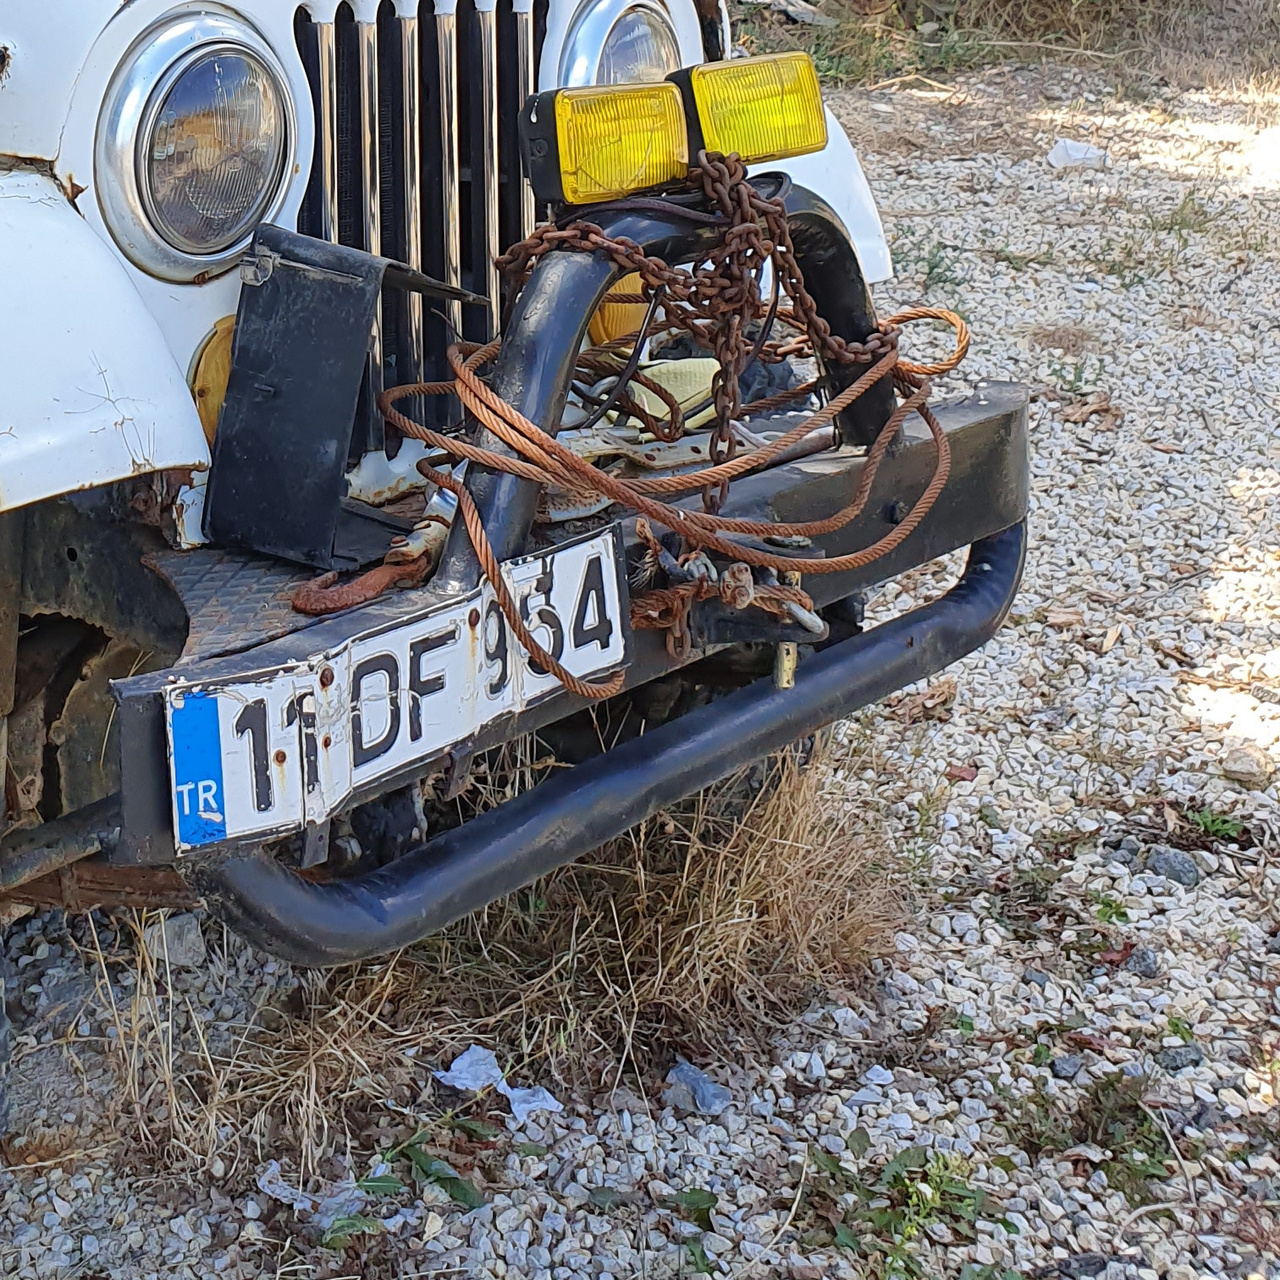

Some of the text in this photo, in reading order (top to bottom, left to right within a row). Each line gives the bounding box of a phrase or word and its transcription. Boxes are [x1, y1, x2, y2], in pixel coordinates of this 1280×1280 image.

[176, 554, 613, 819] TR 11 DF 954
